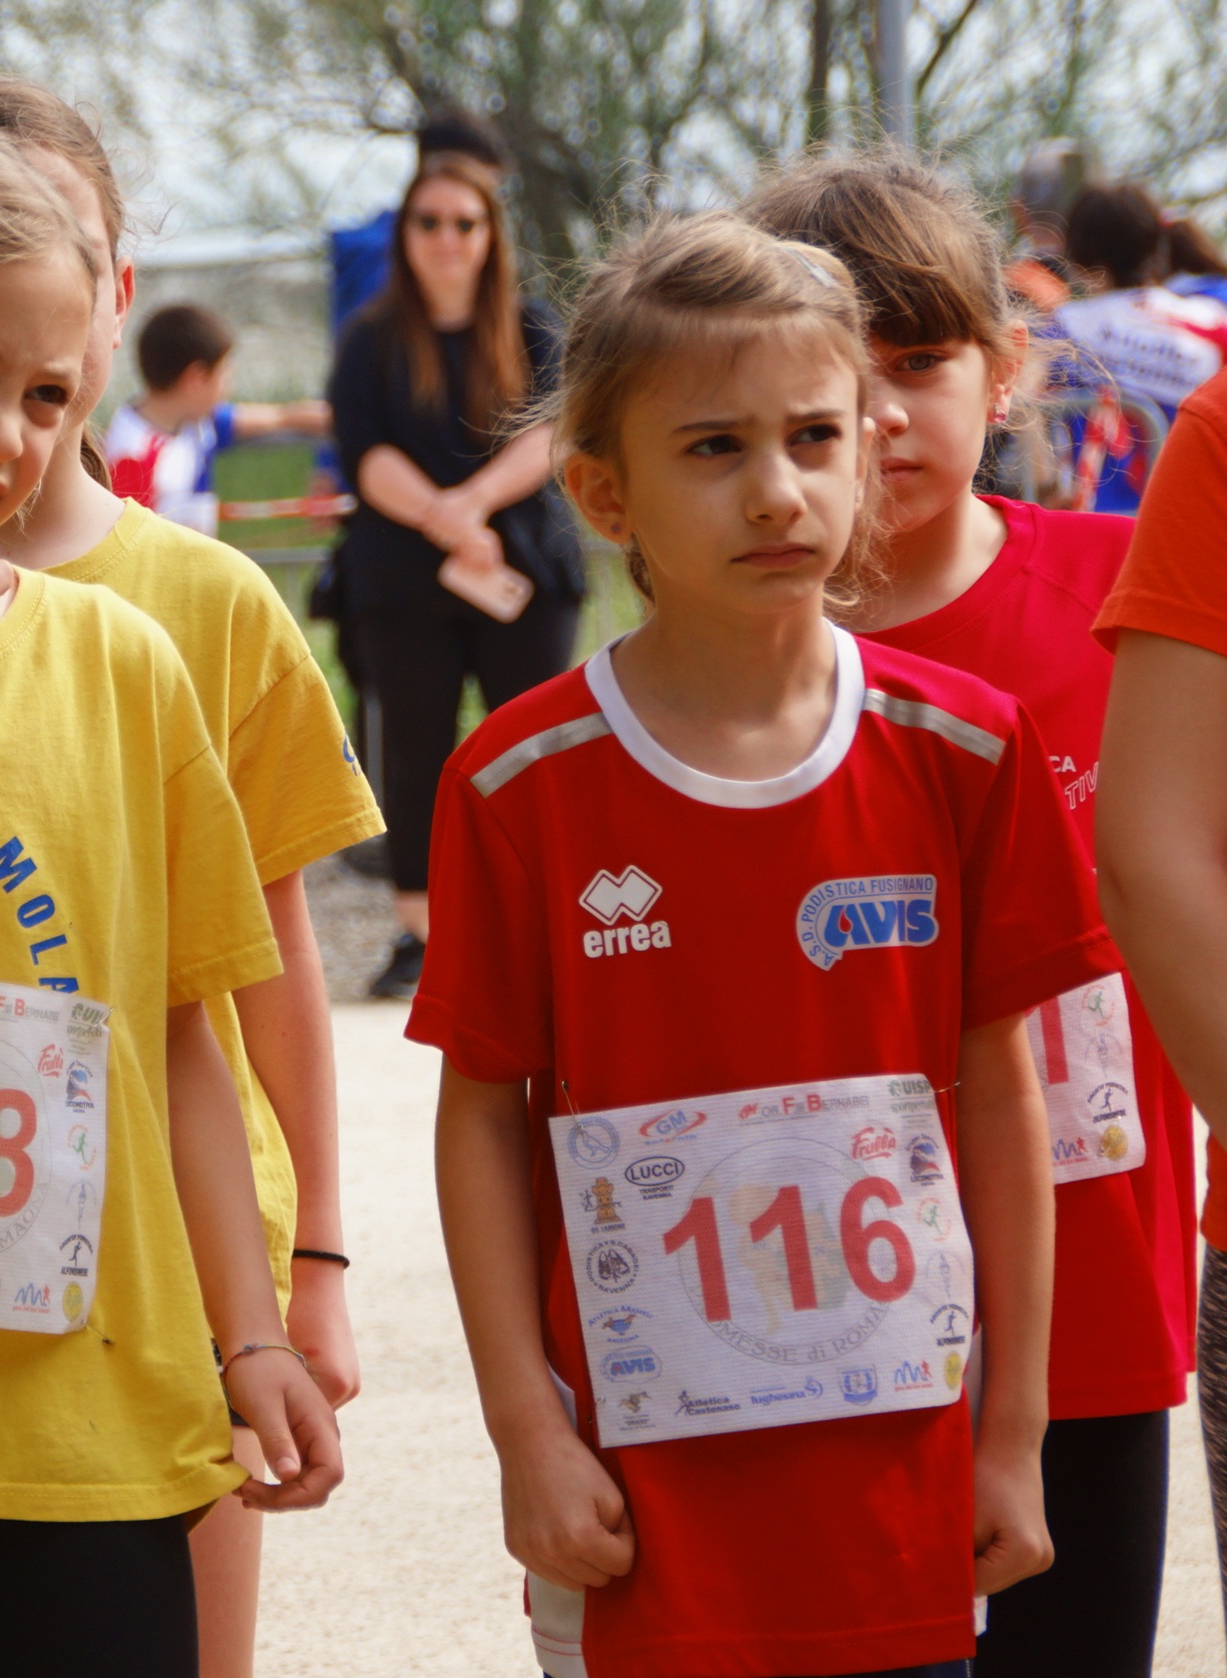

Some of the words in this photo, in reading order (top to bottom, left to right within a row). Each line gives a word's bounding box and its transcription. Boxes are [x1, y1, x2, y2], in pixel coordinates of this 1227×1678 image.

[801, 881, 866, 922] PODISTICA
[870, 877, 934, 893] FUSIGNANO
[824, 899, 936, 947] AVIS
[655, 1109, 687, 1135] GM
[630, 1162, 679, 1182] LUCCI
[663, 1176, 917, 1323] 116
[610, 1357, 656, 1377] AVIS
[688, 1397, 730, 1408] Atletica
[688, 1403, 741, 1416] Castenaso
